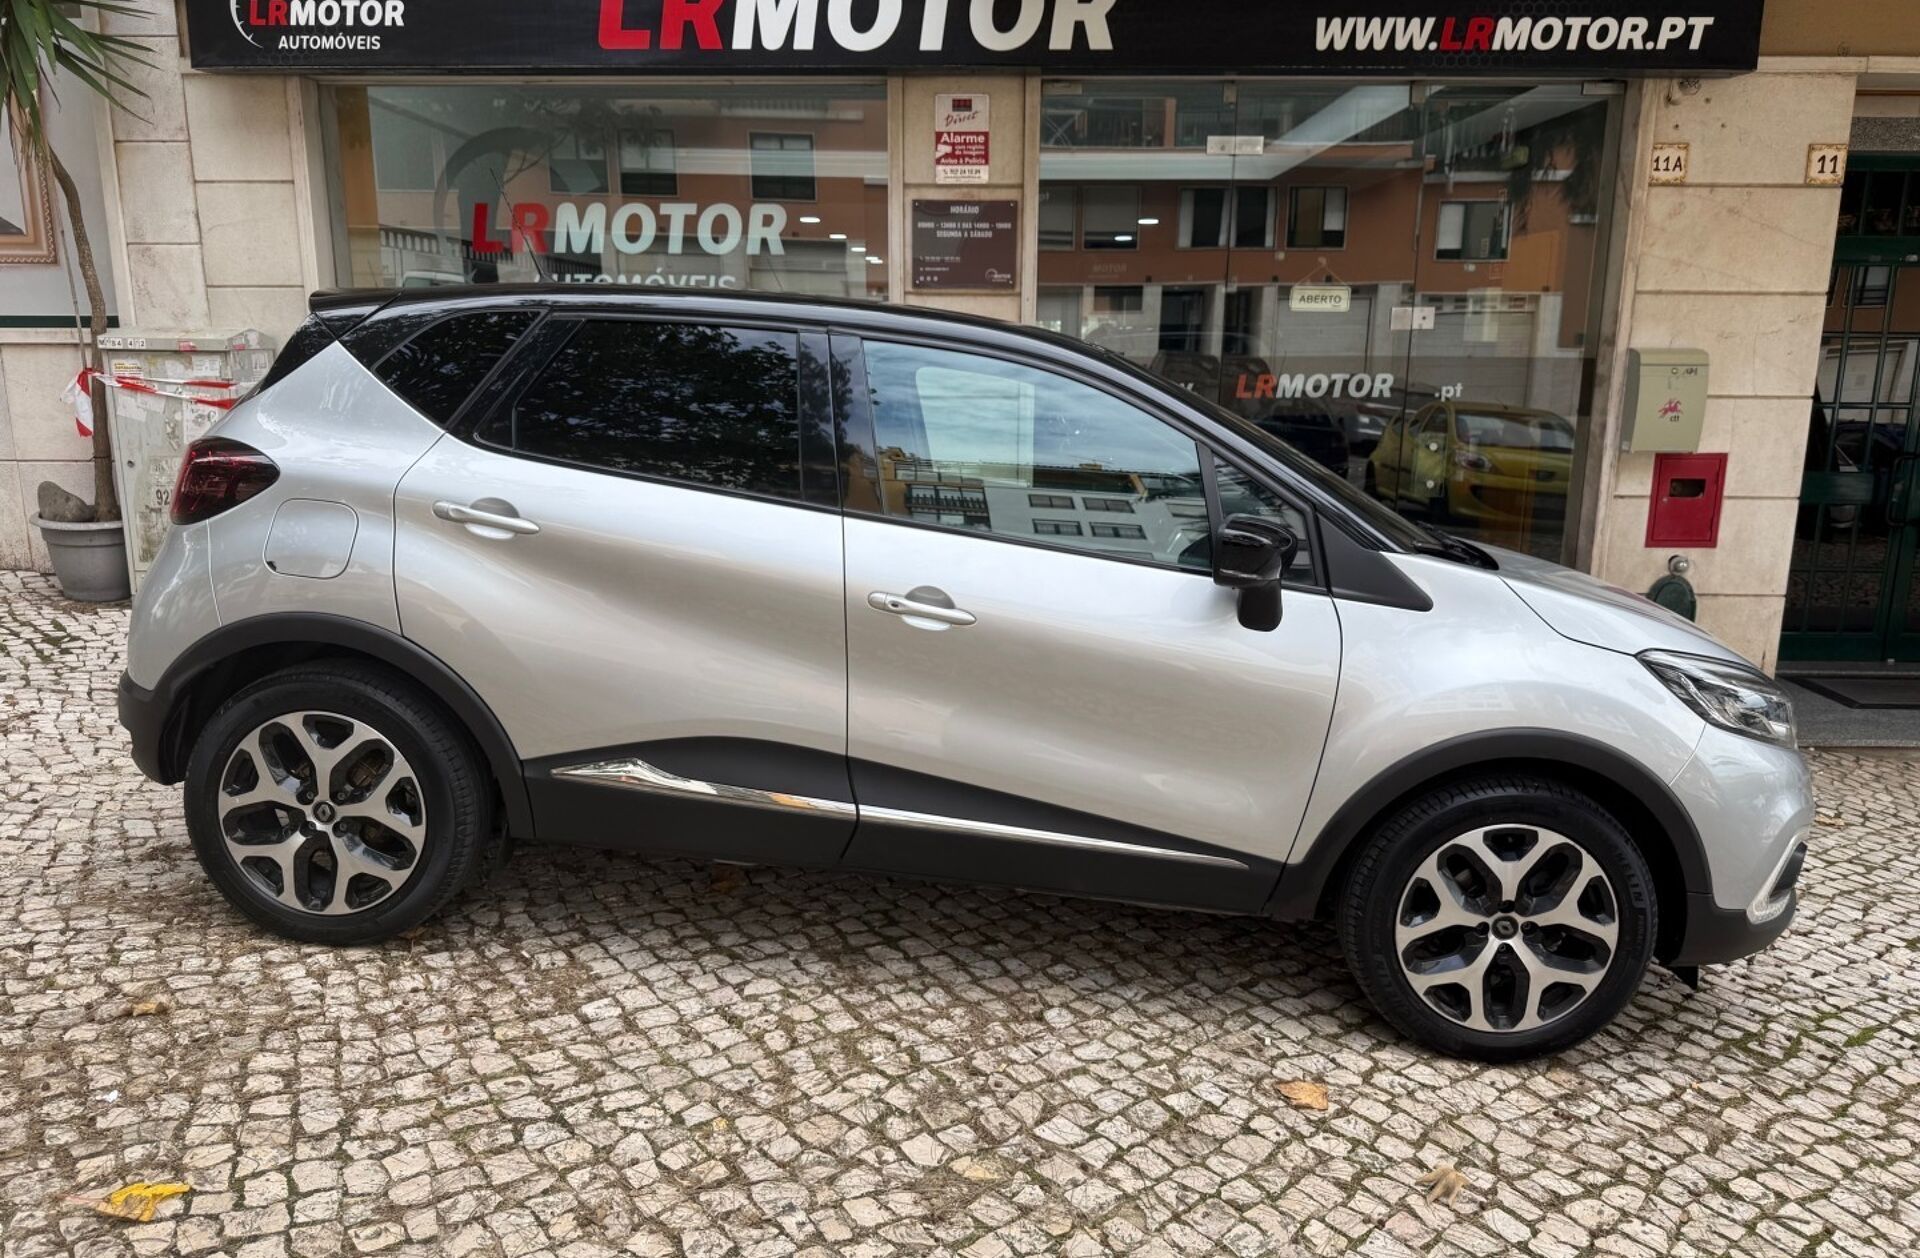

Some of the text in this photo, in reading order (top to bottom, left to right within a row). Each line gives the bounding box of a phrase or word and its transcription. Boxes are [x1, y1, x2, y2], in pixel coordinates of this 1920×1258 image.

[250, 0, 405, 27] LRMOTOR
[278, 33, 381, 50] AUTOMÓVEIS
[1315, 16, 1714, 51] WWW.LRMOTOR.PT
[941, 132, 985, 143] Alarme
[1652, 155, 1683, 172] 11A
[1817, 155, 1839, 174] 11
[472, 202, 788, 256] LRMOTOR
[1298, 294, 1342, 305] ABERTO
[1235, 373, 1463, 401] LRMOTOR .pt
